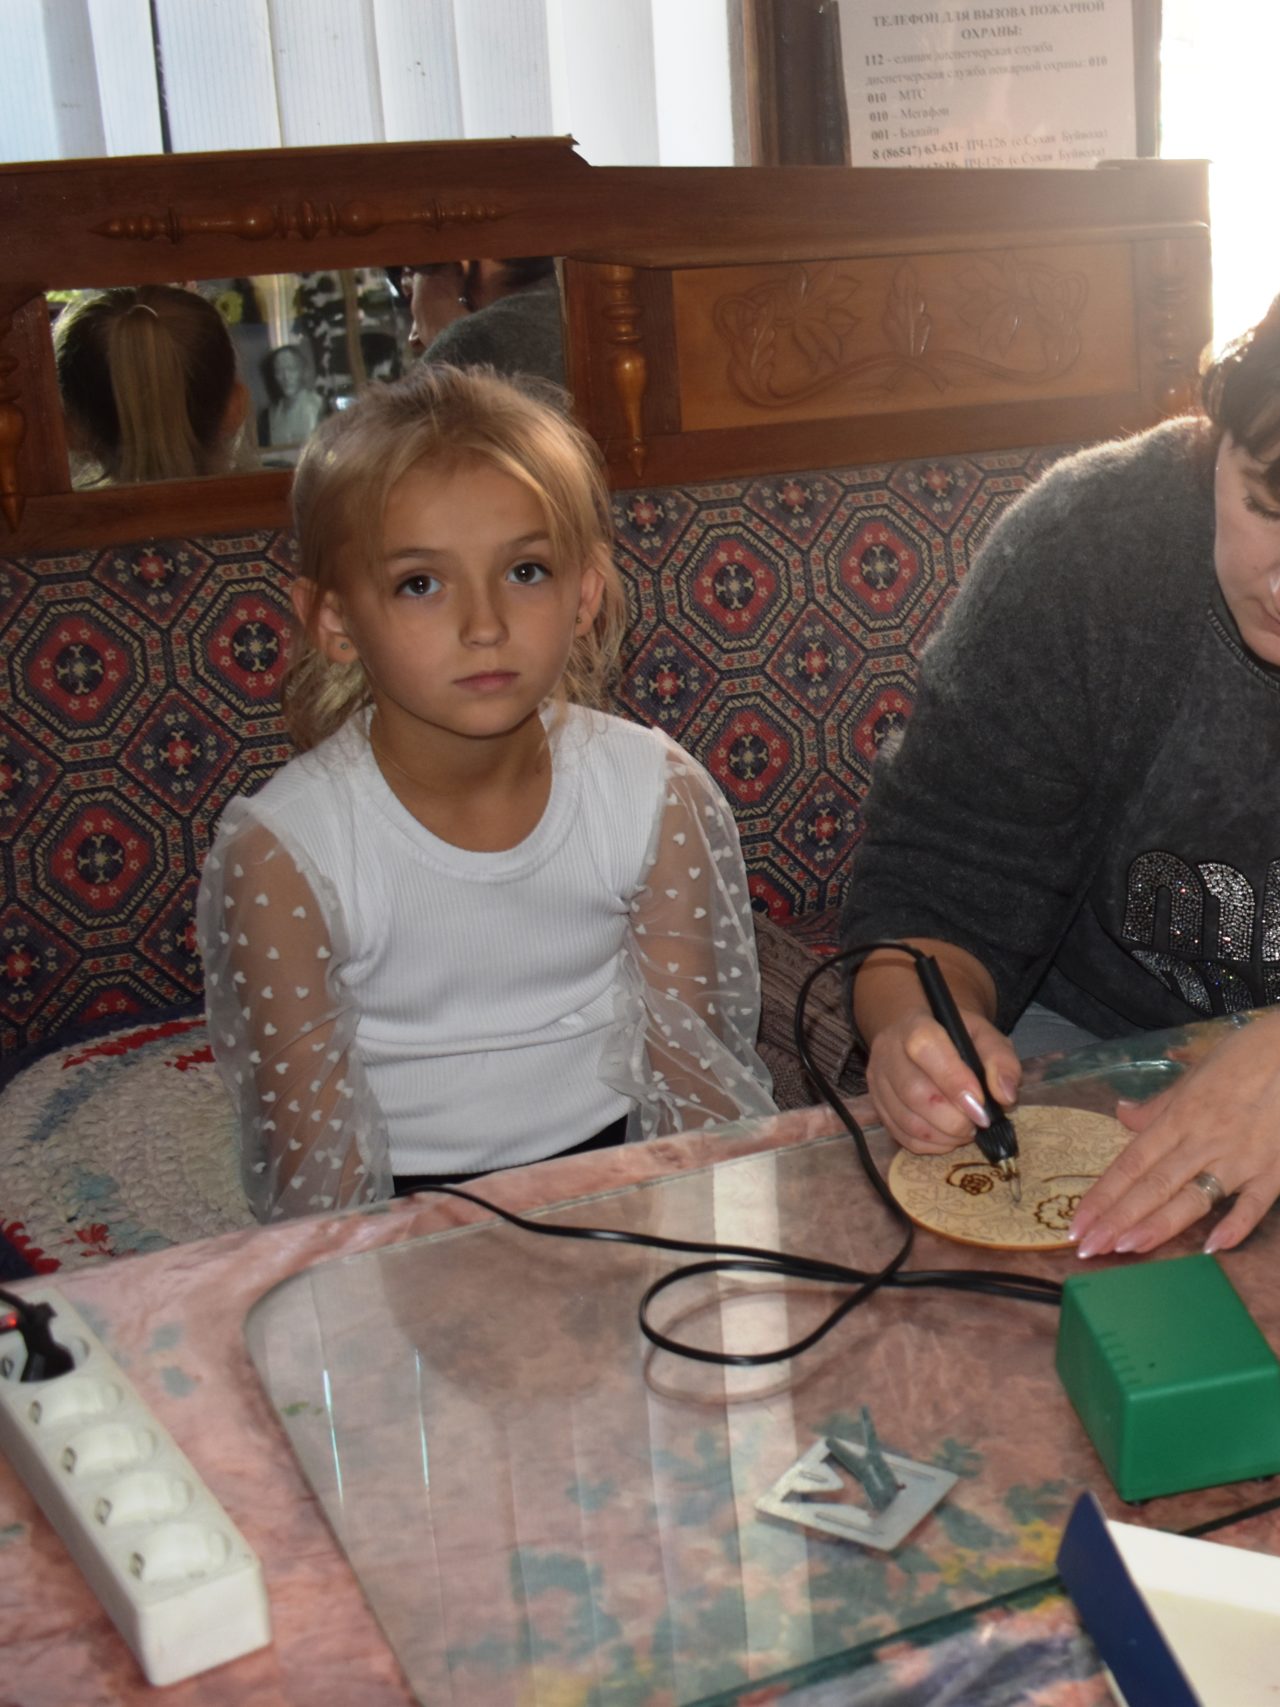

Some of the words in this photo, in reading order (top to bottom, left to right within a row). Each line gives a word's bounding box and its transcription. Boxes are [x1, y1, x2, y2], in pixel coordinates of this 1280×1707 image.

[872, 11, 939, 27] ТЕЛЕФОН
[942, 10, 970, 24] ДЛЯ
[973, 7, 1026, 21] ВЫЗОВА
[1029, 1, 1105, 16] ПОЖАРНОЙ
[960, 24, 1023, 40] ОХРАНЫ:
[864, 53, 885, 67] 112
[866, 92, 887, 105] 010
[898, 88, 927, 101] МТС
[868, 110, 889, 122] 010
[900, 107, 950, 120] Мегафон
